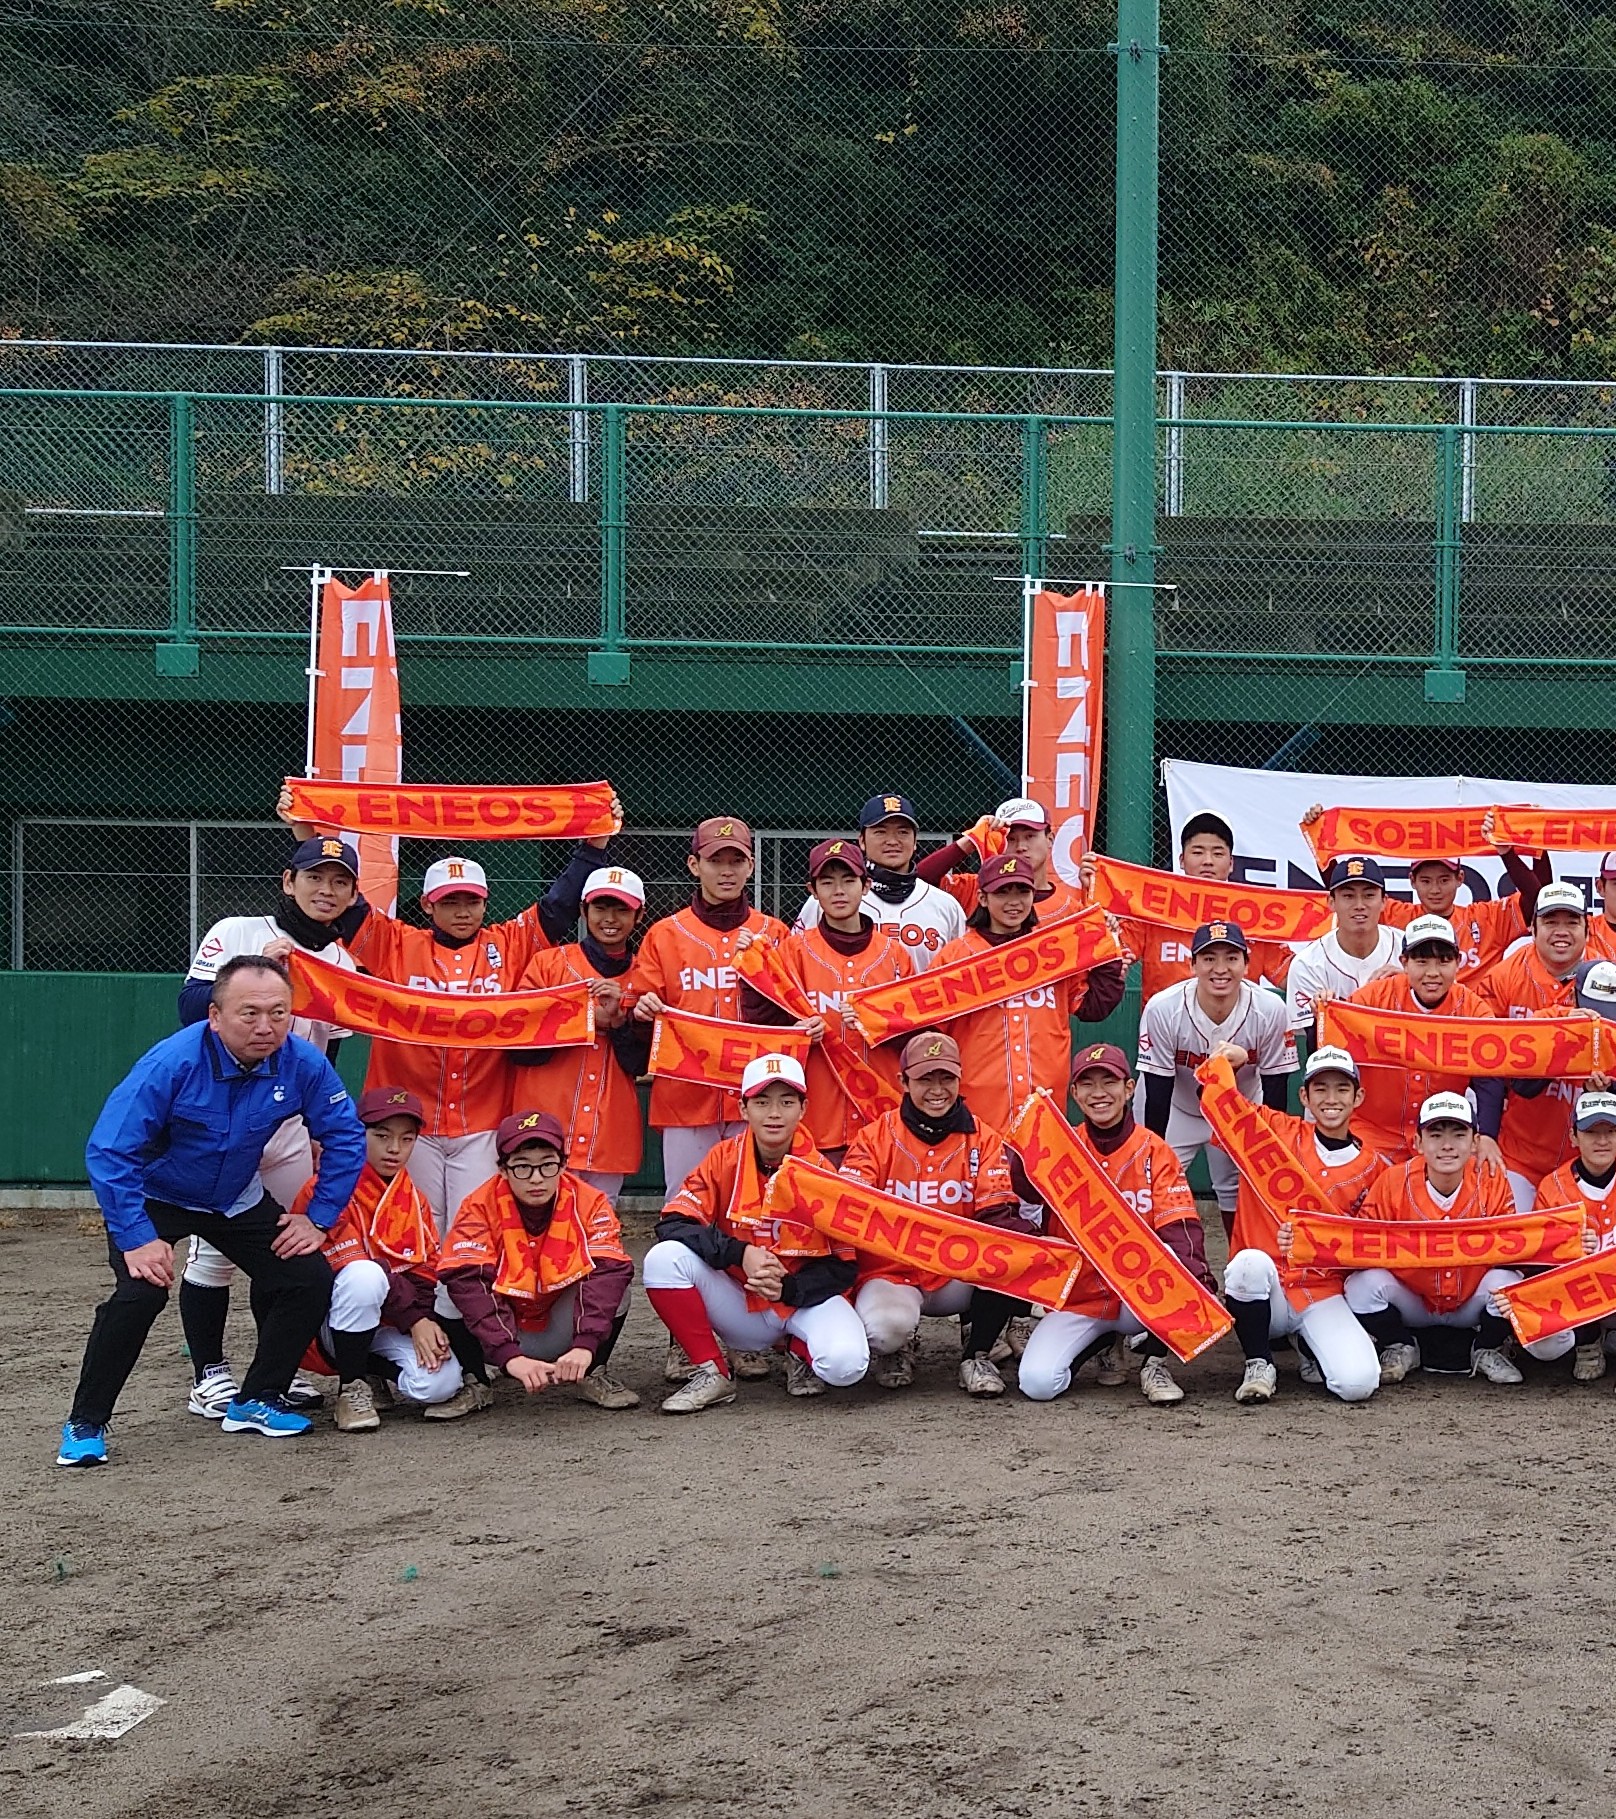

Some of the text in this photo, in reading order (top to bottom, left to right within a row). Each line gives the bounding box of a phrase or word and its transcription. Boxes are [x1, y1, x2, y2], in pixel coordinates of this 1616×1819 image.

[1052, 611, 1091, 889] ENEO
[357, 794, 556, 827] ENEOS
[1142, 882, 1286, 930] ENEOS
[874, 923, 940, 951] EOS
[680, 966, 737, 990] ENE
[911, 935, 1065, 1014] ENEOS
[345, 988, 530, 1039] ENEOS
[1375, 1027, 1537, 1069] ENEOS
[1214, 1088, 1322, 1212] ENEOS
[830, 1194, 1013, 1278] ENEOS
[1048, 1153, 1175, 1304] ENEOS
[1352, 1228, 1527, 1259] ENEOS
